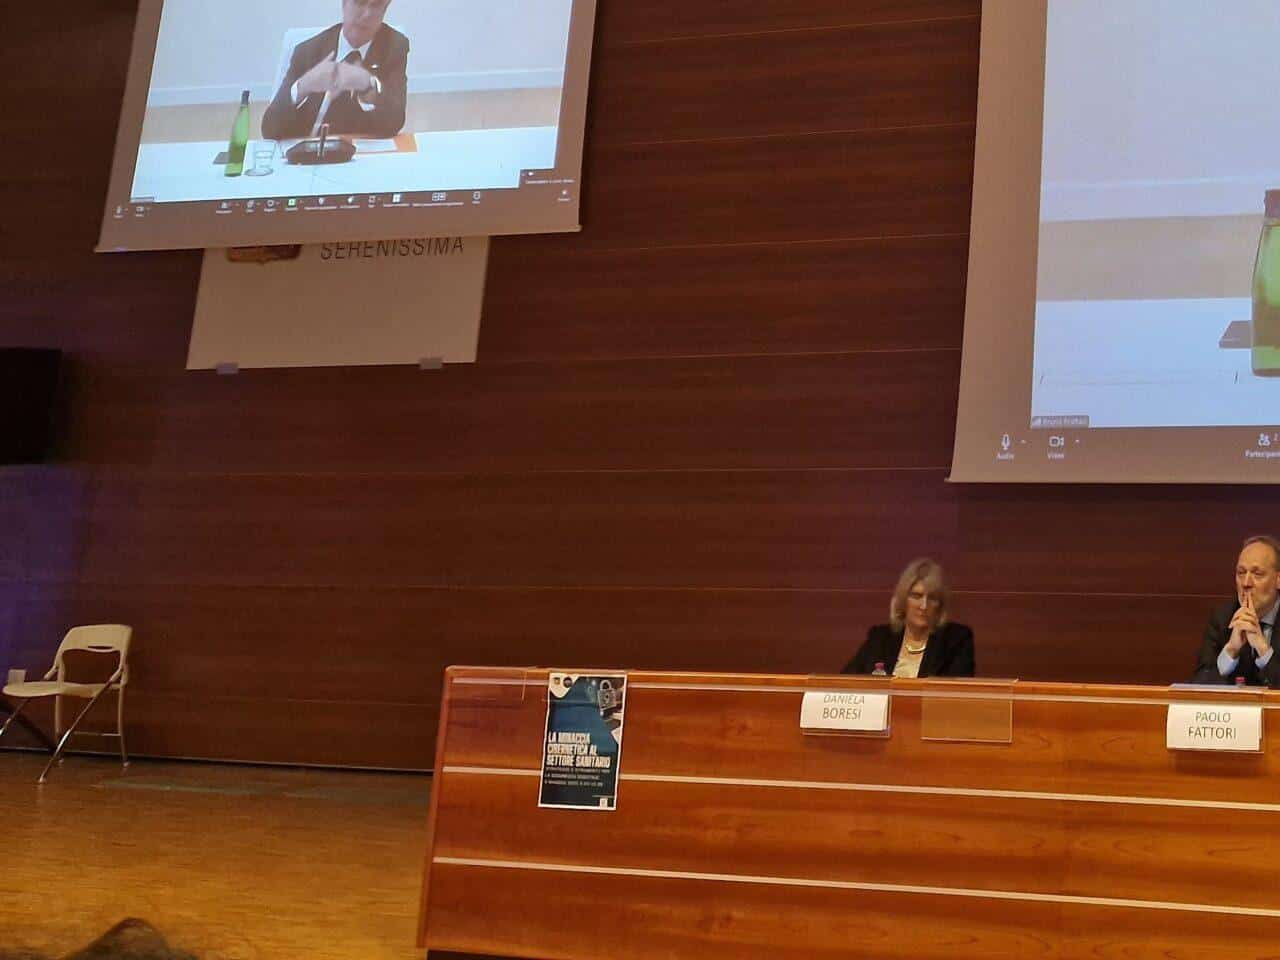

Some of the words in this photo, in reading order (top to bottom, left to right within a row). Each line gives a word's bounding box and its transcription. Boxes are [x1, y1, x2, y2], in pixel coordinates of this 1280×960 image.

[823, 694, 865, 705] DANIELA
[822, 707, 861, 720] BORESI
[1195, 711, 1231, 723] PAOLO
[1188, 726, 1237, 739] FATTORI
